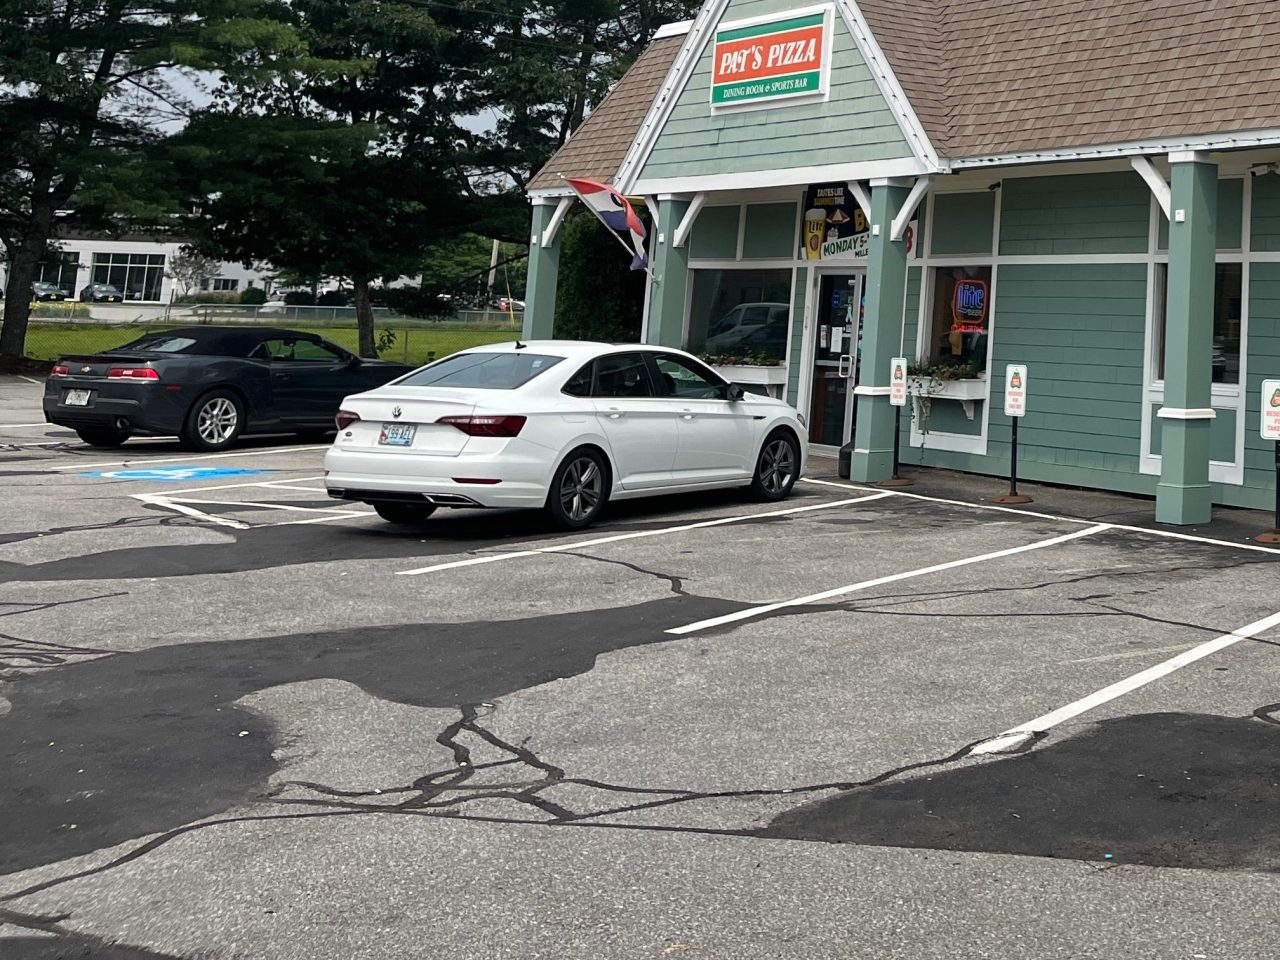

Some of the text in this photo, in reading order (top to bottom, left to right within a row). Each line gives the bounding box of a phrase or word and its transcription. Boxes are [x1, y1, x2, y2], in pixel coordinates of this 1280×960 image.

[719, 37, 817, 75] PAT'S PIZZA
[723, 85, 745, 98] DINING
[745, 83, 764, 95] ROOM
[770, 80, 794, 91] SPORTS
[794, 77, 808, 89] BAR
[823, 237, 858, 256] MONDAY
